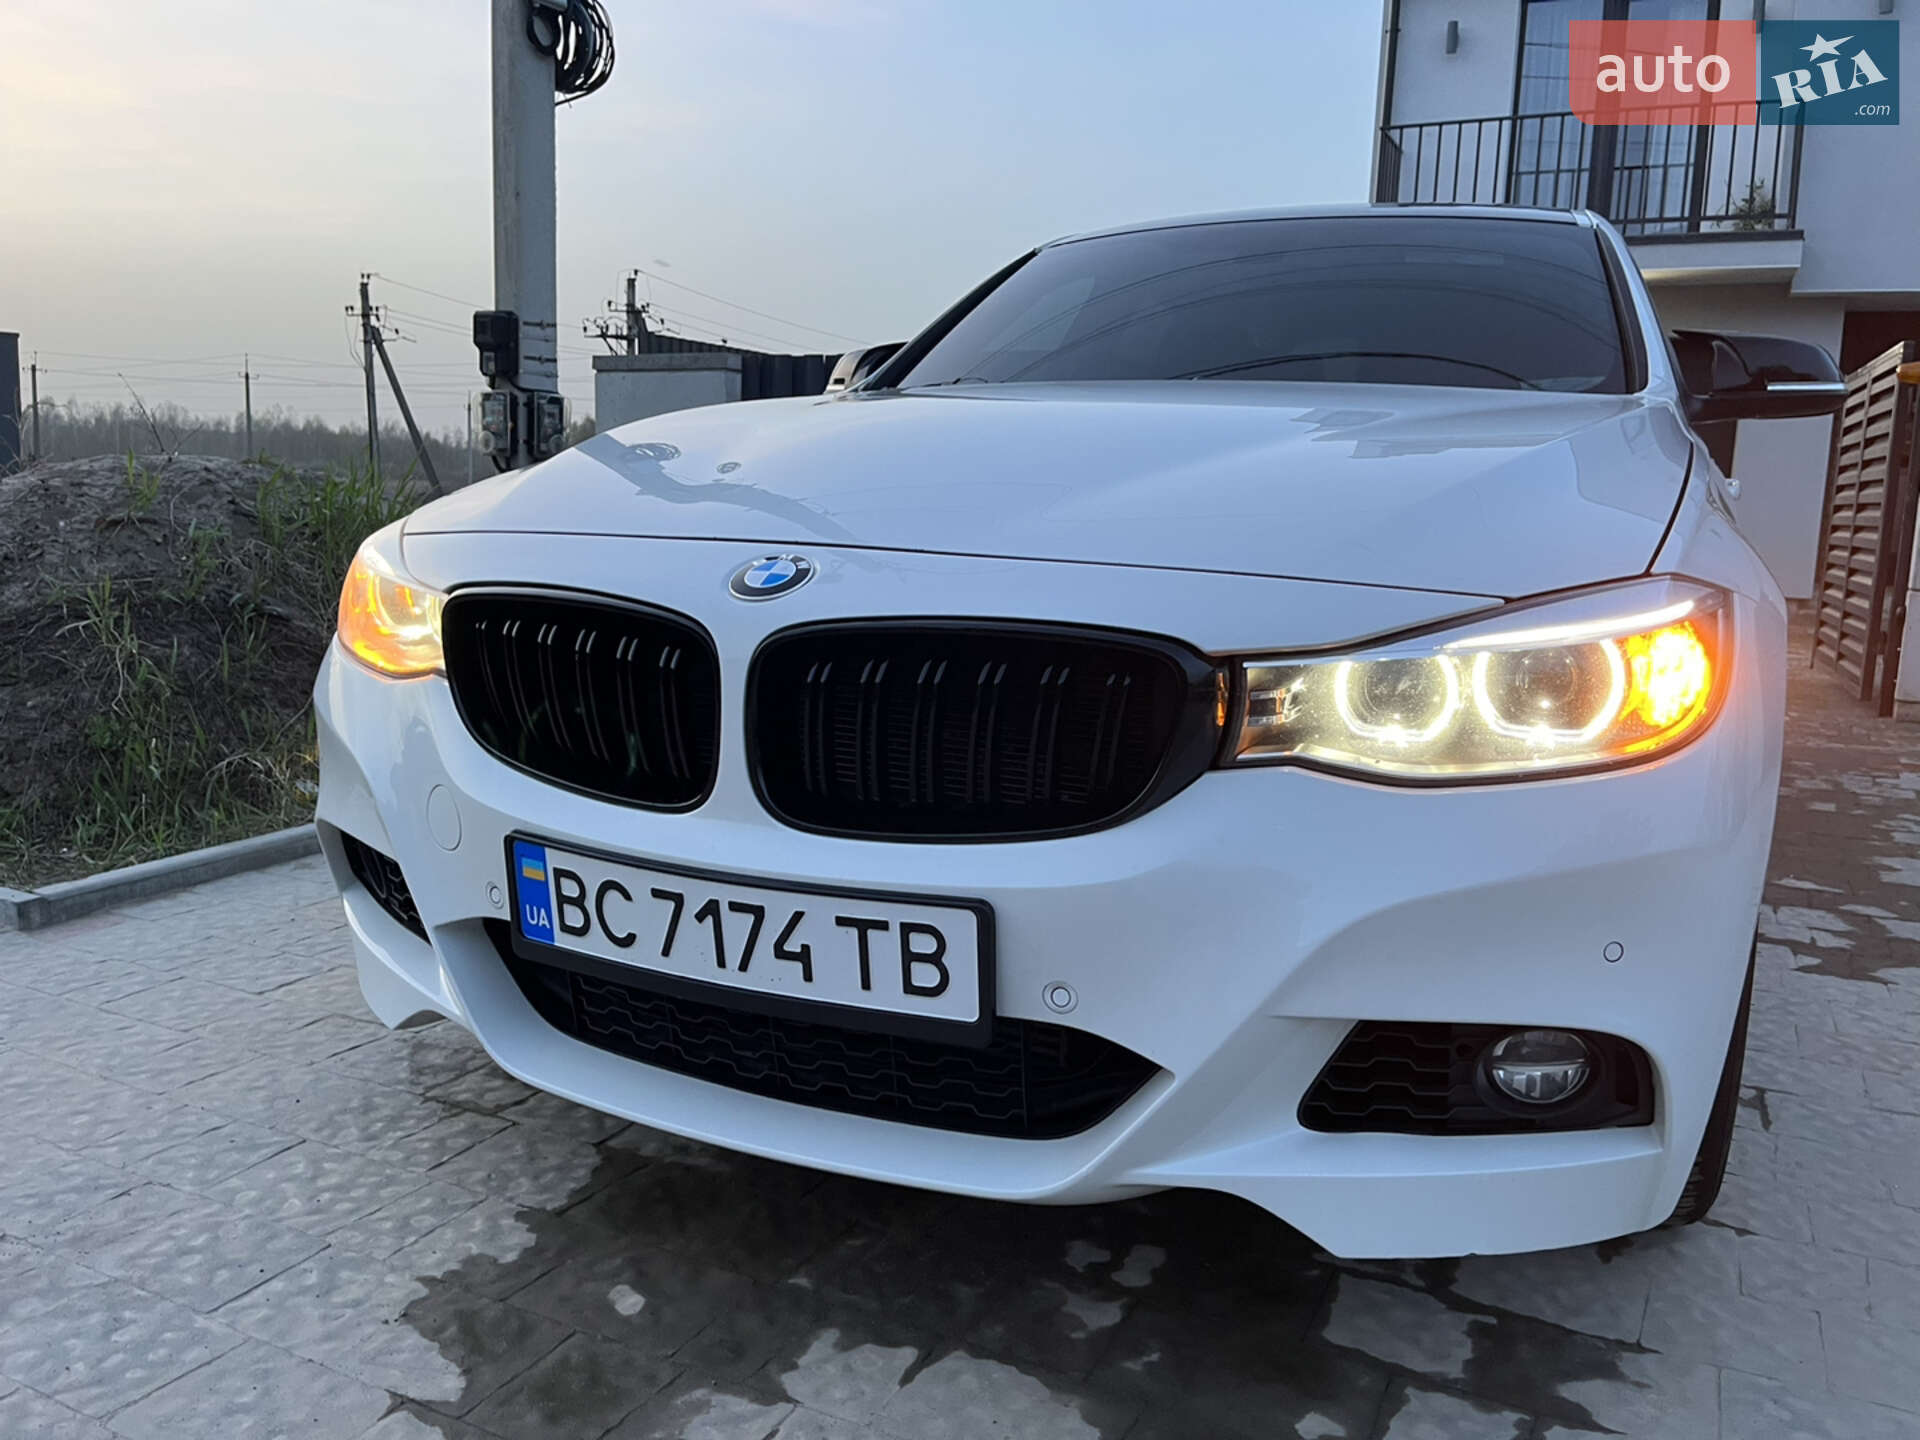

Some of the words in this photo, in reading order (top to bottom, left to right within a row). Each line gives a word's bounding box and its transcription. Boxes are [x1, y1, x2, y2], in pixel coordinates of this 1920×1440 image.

[526, 903, 551, 929] UA
[552, 866, 637, 948] BC
[650, 886, 814, 983] 7174
[835, 914, 950, 998] TB
